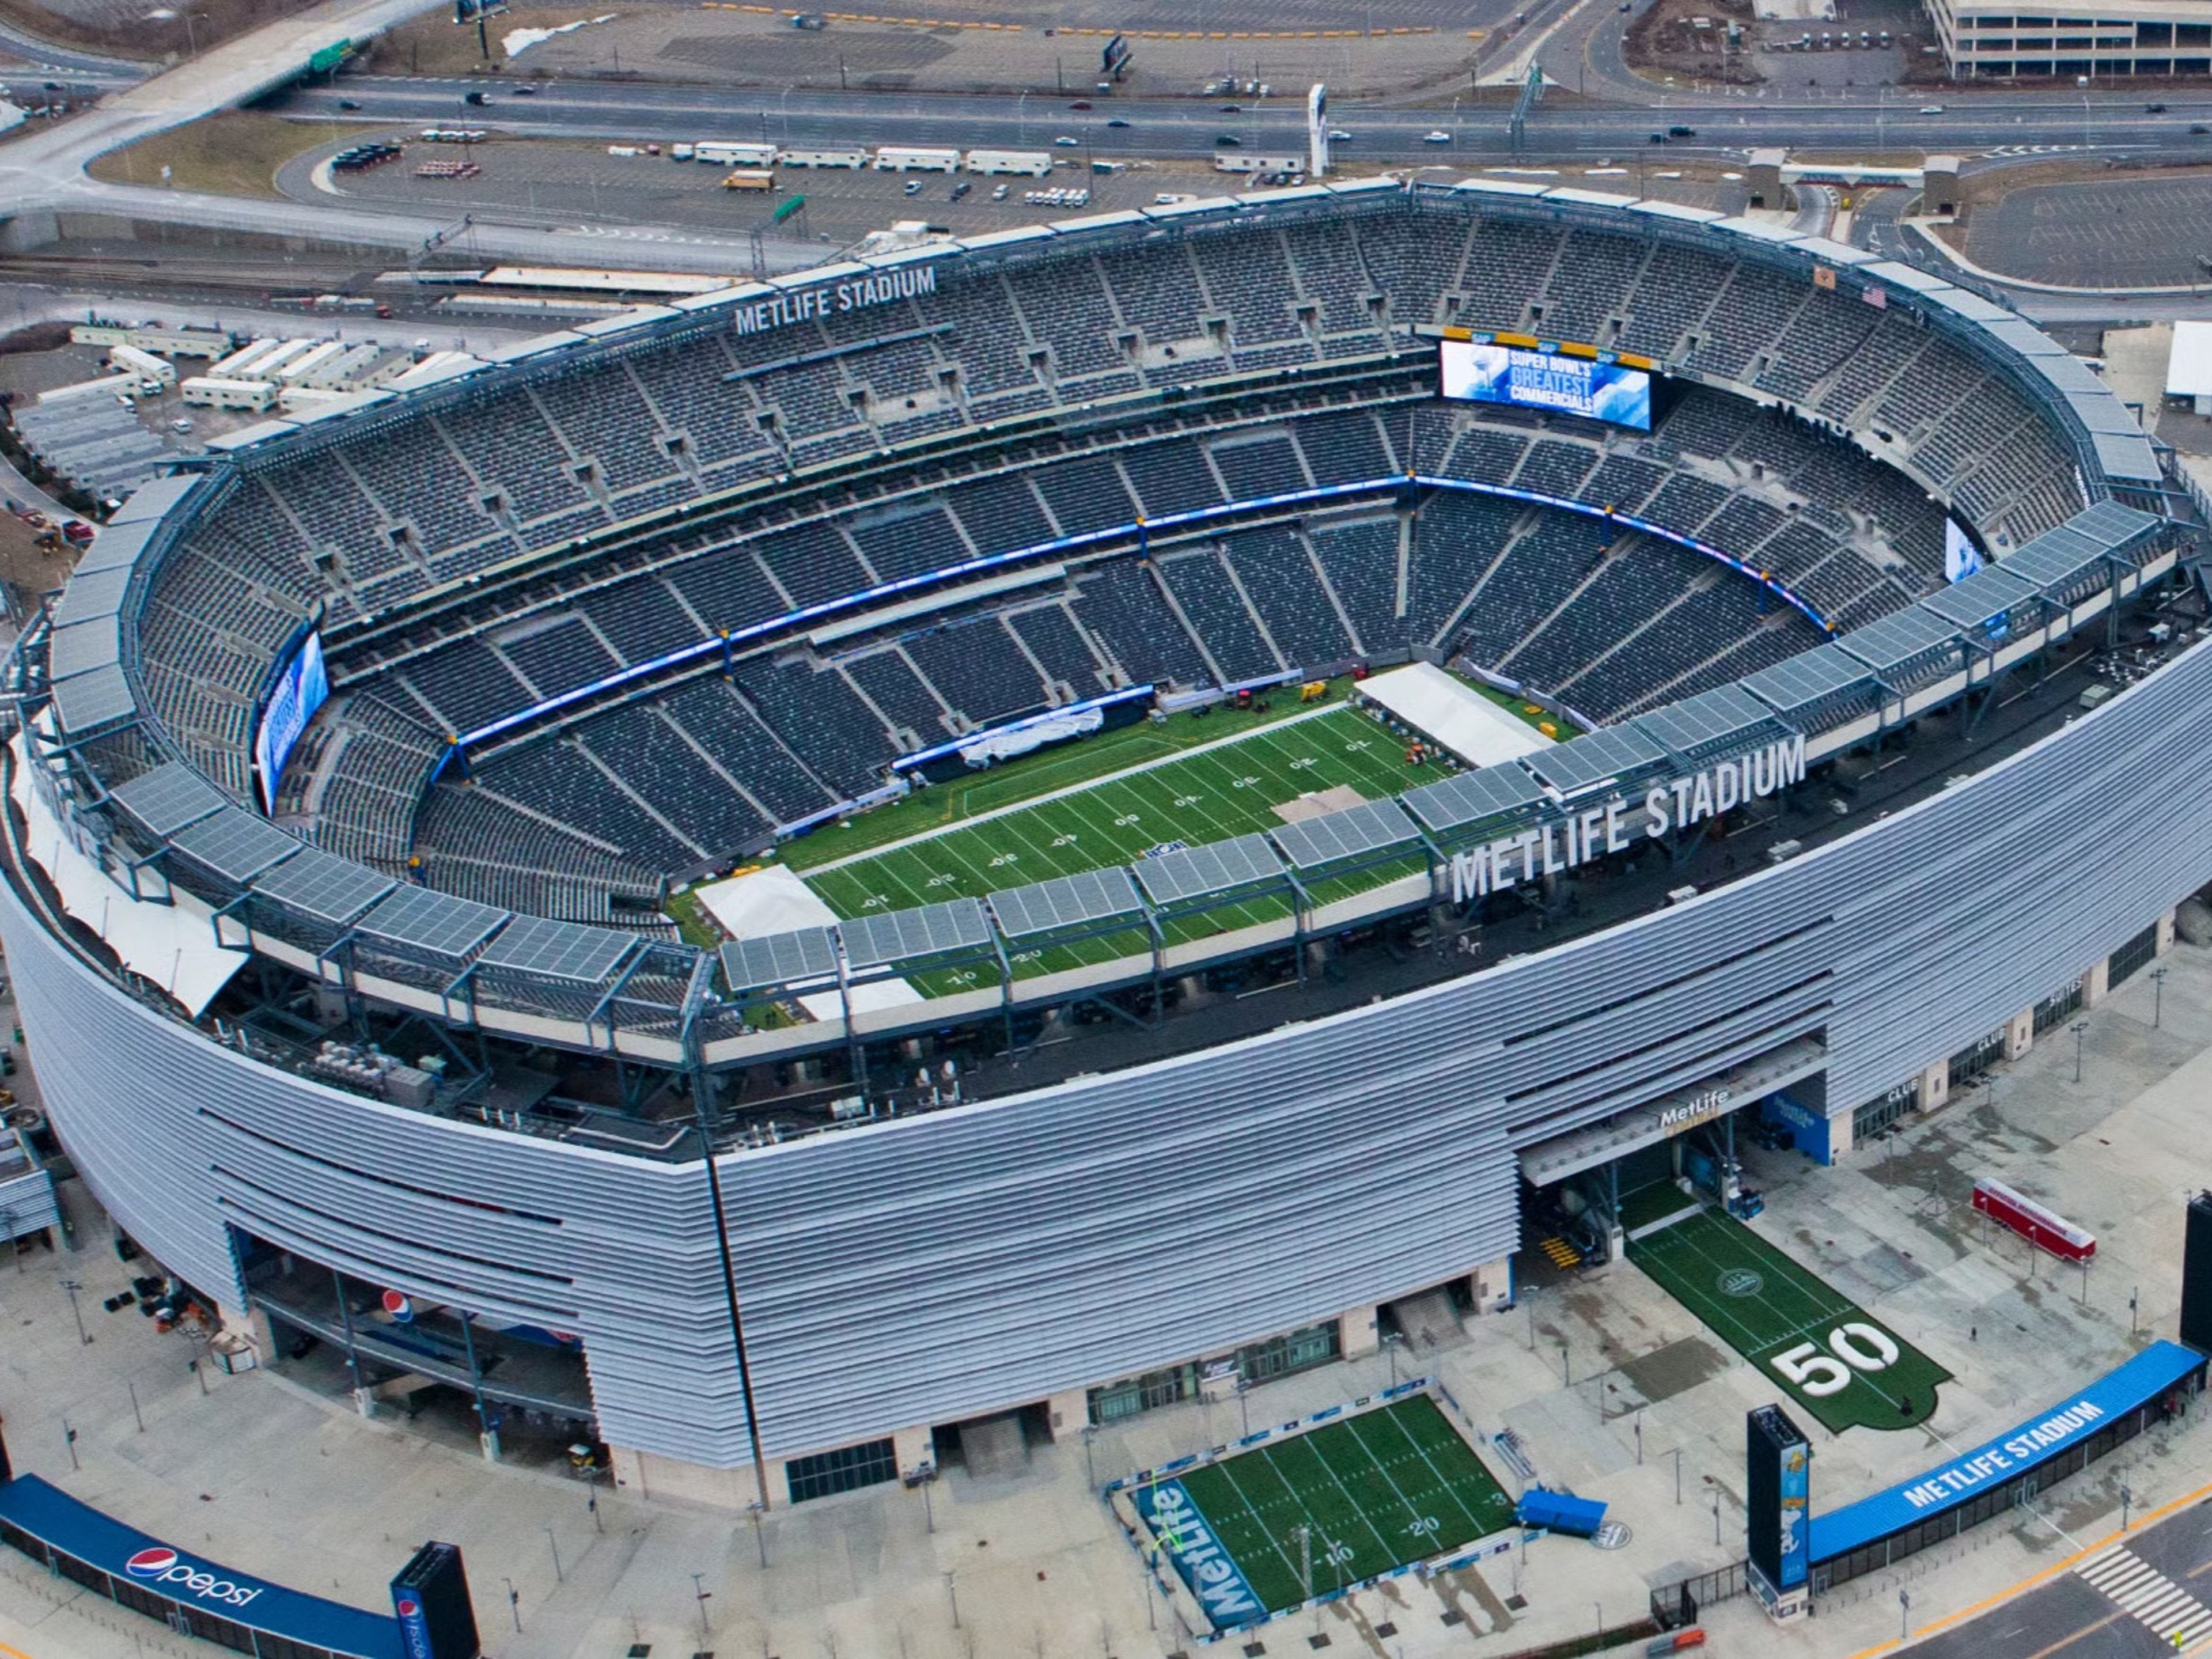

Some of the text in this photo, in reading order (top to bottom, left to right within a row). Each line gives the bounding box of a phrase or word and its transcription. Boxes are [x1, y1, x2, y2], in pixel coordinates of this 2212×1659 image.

[735, 266, 936, 335] METLIFE STADIUM
[1510, 350, 1548, 370] SUPER
[1510, 367, 1592, 397] GREATEST
[1510, 386, 1593, 412] COMMERCIALS
[1173, 795, 1199, 808] 40
[1114, 814, 1141, 827] 50
[1452, 733, 1806, 903] METLIFE STADIUM
[1056, 833, 1078, 847] 40
[993, 853, 1018, 867] 30
[931, 873, 956, 887] 20
[867, 893, 890, 908] 10
[2049, 979, 2083, 1007] SUITES
[1660, 1089, 1729, 1128] MetLife
[1770, 1322, 1899, 1397] 50
[1902, 1400, 2104, 1508] METLIFE STADIUM
[1408, 1516, 1440, 1537] 20
[1149, 1487, 1257, 1616] MetLife
[1325, 1547, 1354, 1567] 10
[157, 1565, 263, 1607] pepsi
